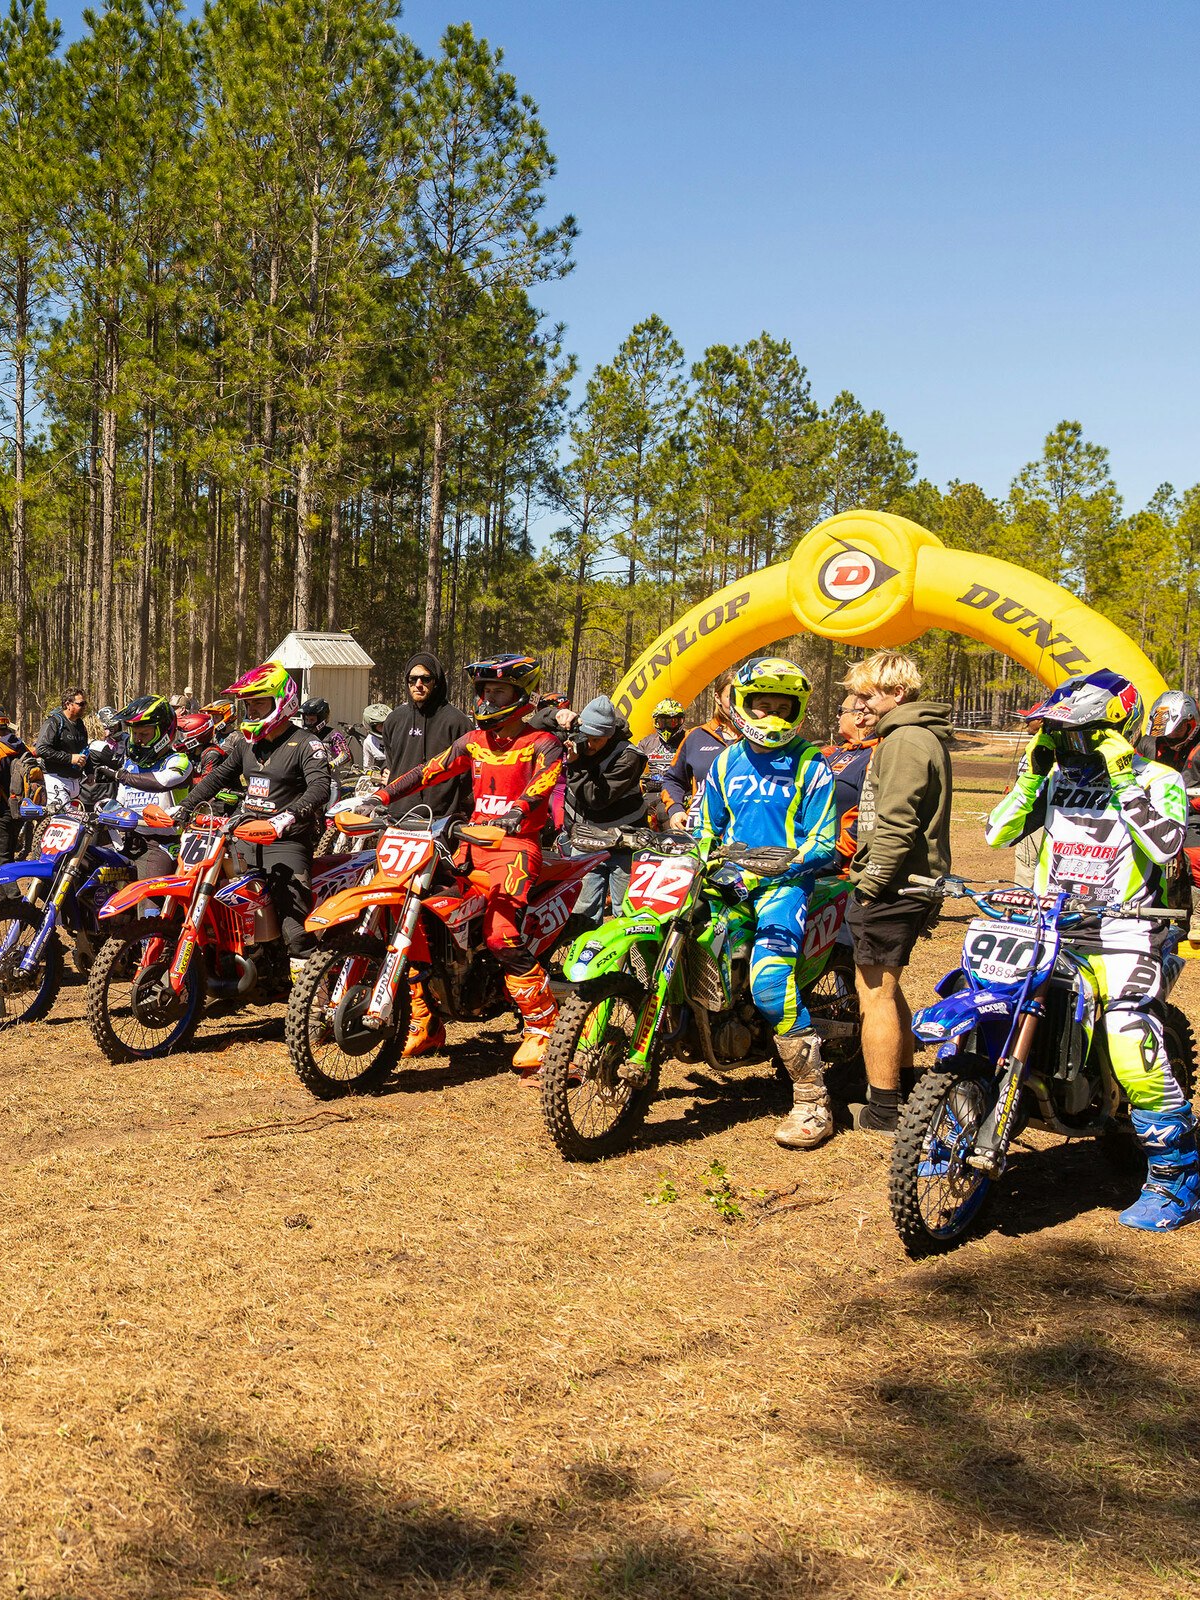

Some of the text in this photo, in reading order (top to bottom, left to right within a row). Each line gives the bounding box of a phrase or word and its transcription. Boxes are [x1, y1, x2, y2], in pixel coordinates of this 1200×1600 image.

[957, 583, 1091, 675] DUNL
[614, 592, 750, 719] DUNLOP
[744, 725, 765, 742] 3062
[126, 791, 158, 801] VALLEY
[248, 786, 269, 797] MOLY
[727, 775, 795, 798] FXR
[125, 797, 159, 807] YAMAHA
[476, 794, 516, 815] KTM
[379, 837, 430, 872] 511
[629, 863, 693, 904] 212
[990, 893, 1056, 909] RENTHA
[534, 896, 570, 934] 511
[625, 925, 656, 935] FUSION
[596, 951, 618, 969] FXR
[967, 933, 1047, 971] 910
[996, 1073, 1019, 1137] PRO CIRCUIT
